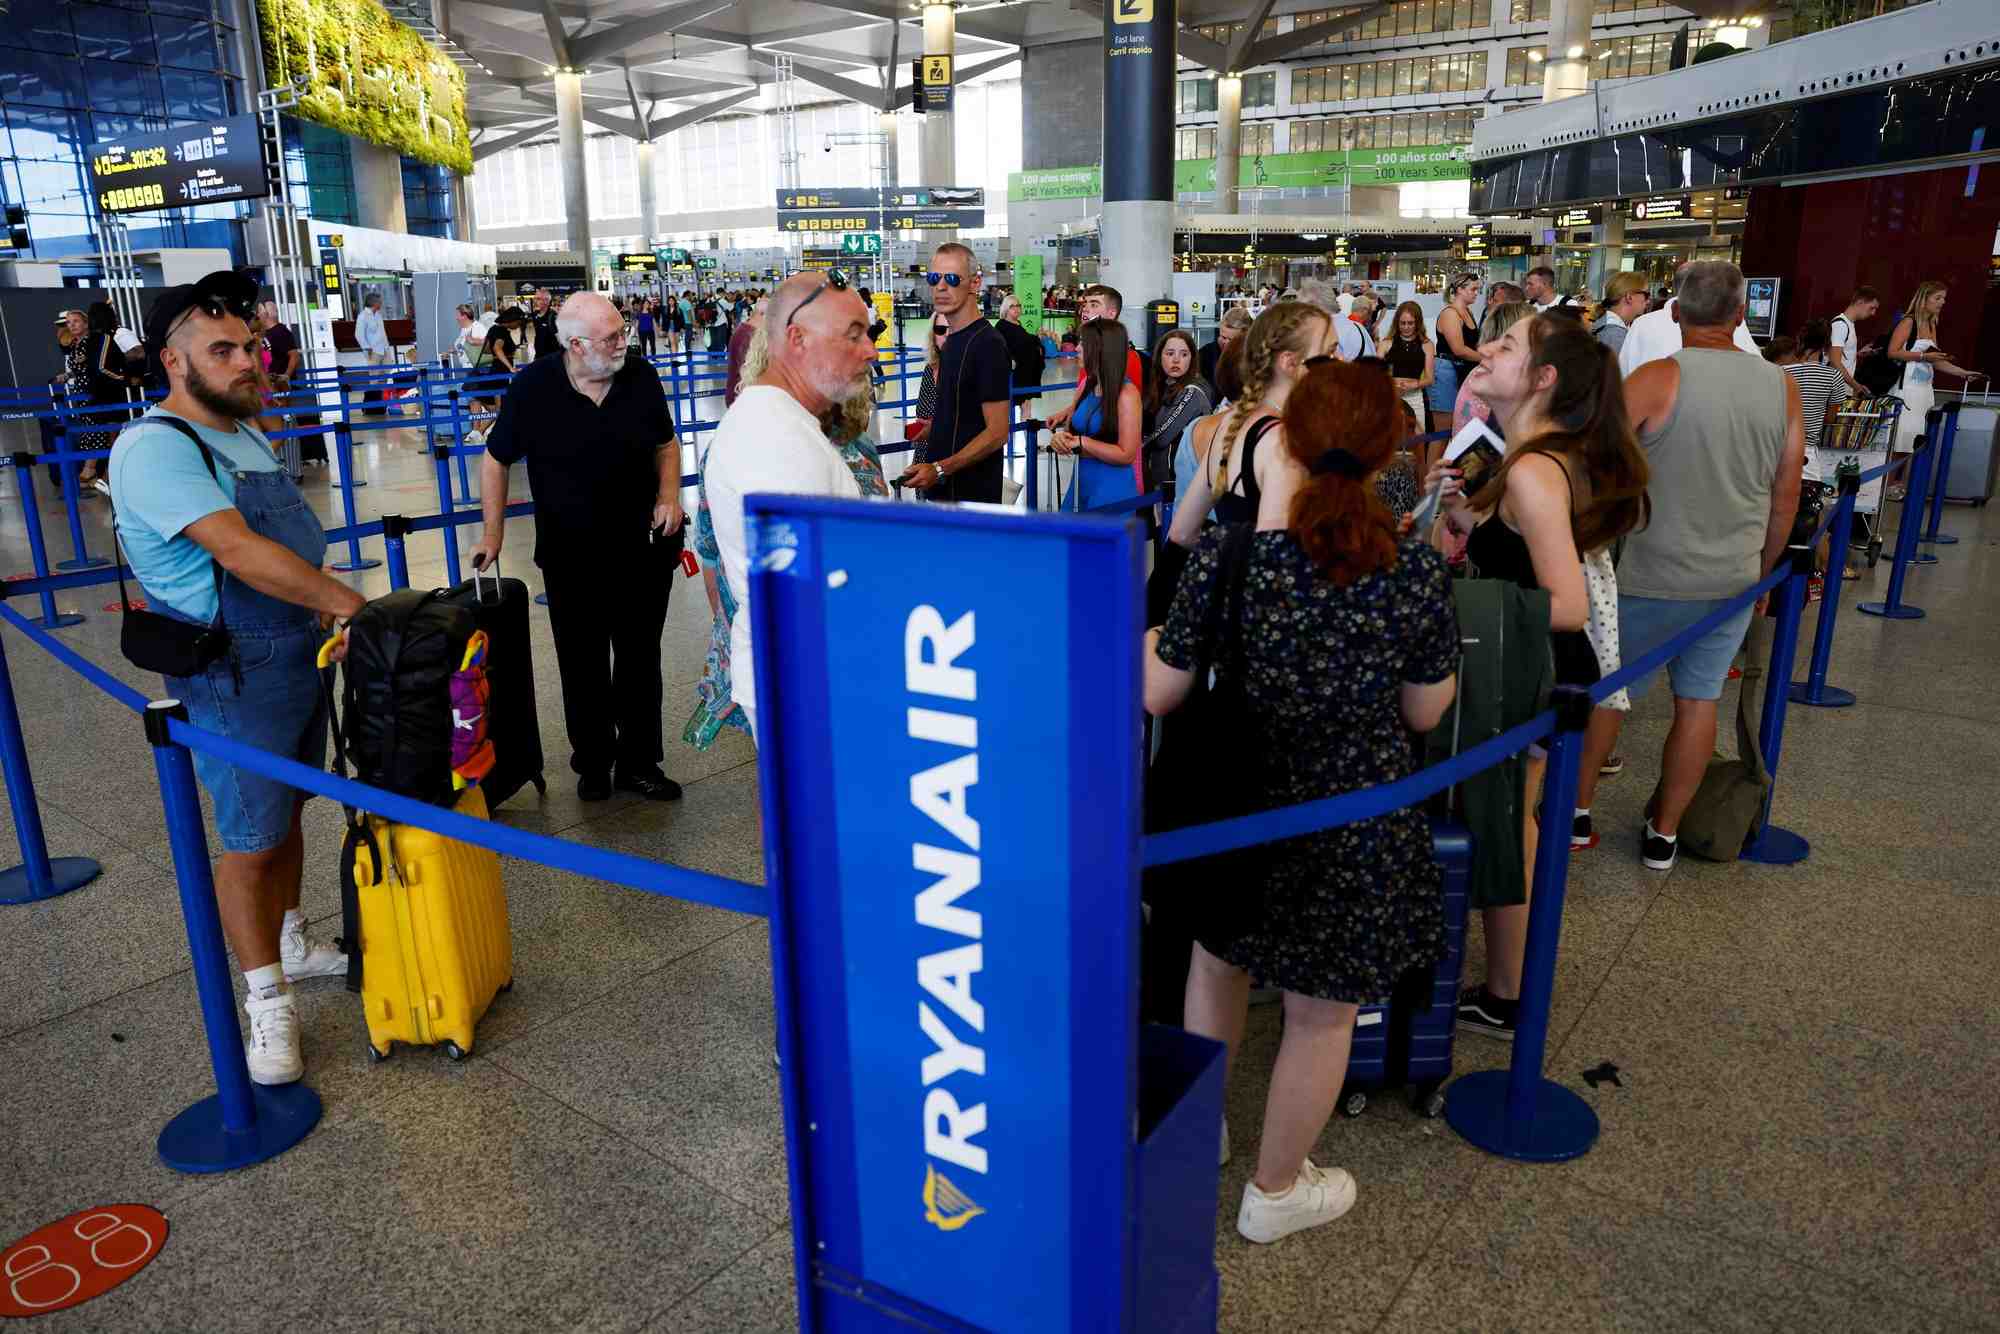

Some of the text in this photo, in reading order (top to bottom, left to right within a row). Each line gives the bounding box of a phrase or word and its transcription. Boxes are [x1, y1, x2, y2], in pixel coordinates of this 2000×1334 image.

[1110, 46, 1127, 56] Carril
[1376, 152, 1397, 164] 100
[1399, 151, 1426, 163] años
[1375, 168, 1396, 179] 100
[1399, 167, 1428, 178] Years
[904, 604, 988, 1174] RYANAIR
